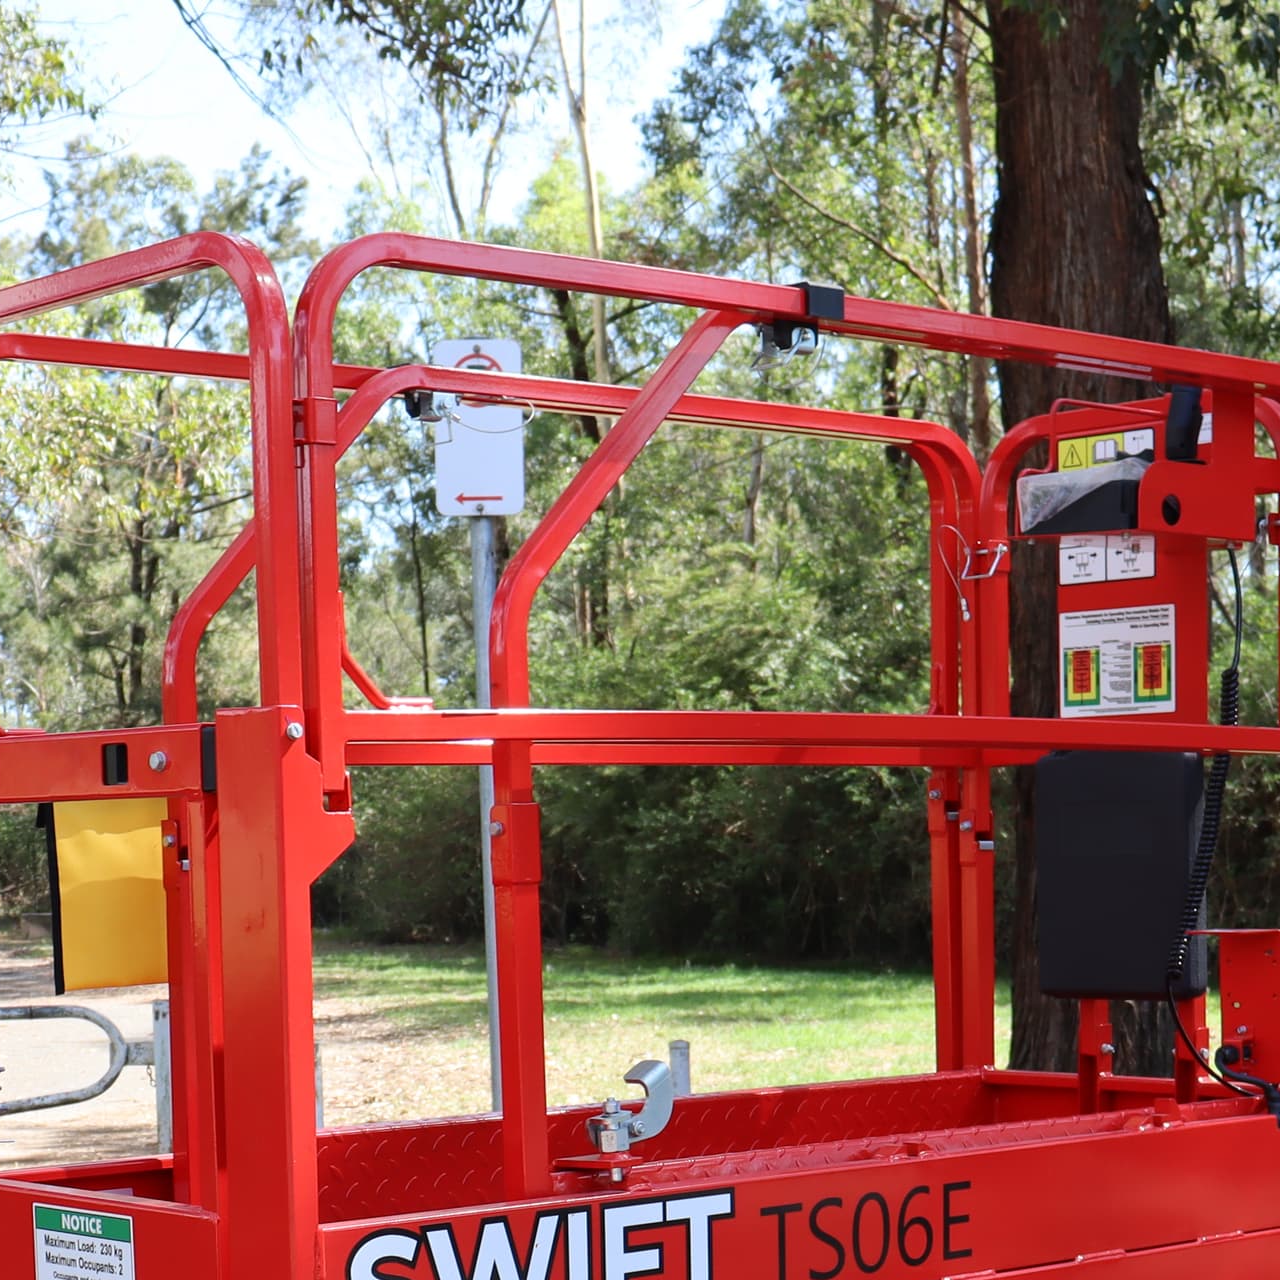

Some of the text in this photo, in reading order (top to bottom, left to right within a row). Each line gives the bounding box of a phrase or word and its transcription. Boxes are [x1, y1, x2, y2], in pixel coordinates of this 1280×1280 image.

[61, 1213, 103, 1235] NOTICE
[44, 1234, 123, 1261] Maximum Load: 230 kg
[45, 1251, 124, 1276] Maximum Occupants: 2
